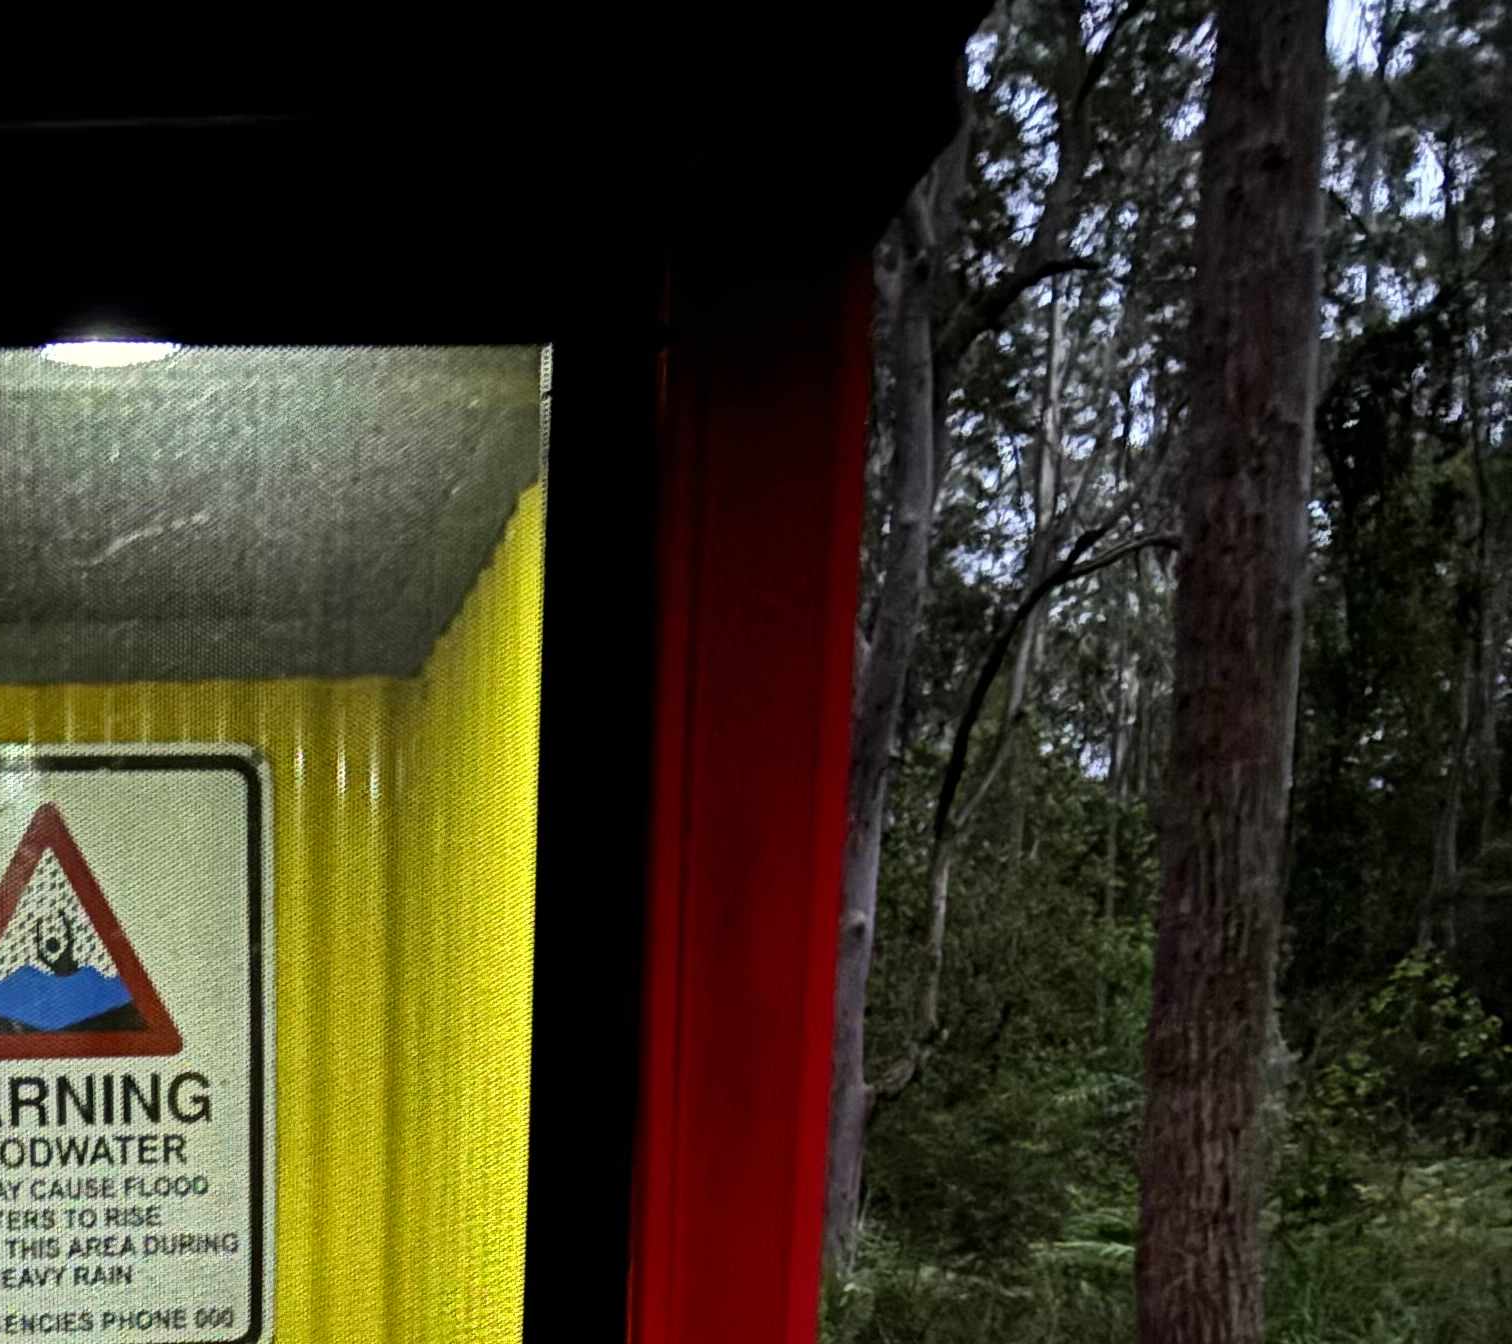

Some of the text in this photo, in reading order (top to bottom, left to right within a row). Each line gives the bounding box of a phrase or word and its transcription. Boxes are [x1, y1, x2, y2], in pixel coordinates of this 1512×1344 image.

[30, 1178, 115, 1200] CAUSE
[124, 1176, 209, 1198] FLOOD
[66, 1208, 96, 1229] TO
[105, 1206, 162, 1228] RISE
[5, 1238, 60, 1259] THIS
[67, 1236, 136, 1258] AREA
[144, 1233, 239, 1257] DURING
[74, 1265, 133, 1286] RAIN
[102, 1310, 185, 1331] PHONE
[195, 1308, 235, 1328] 000
